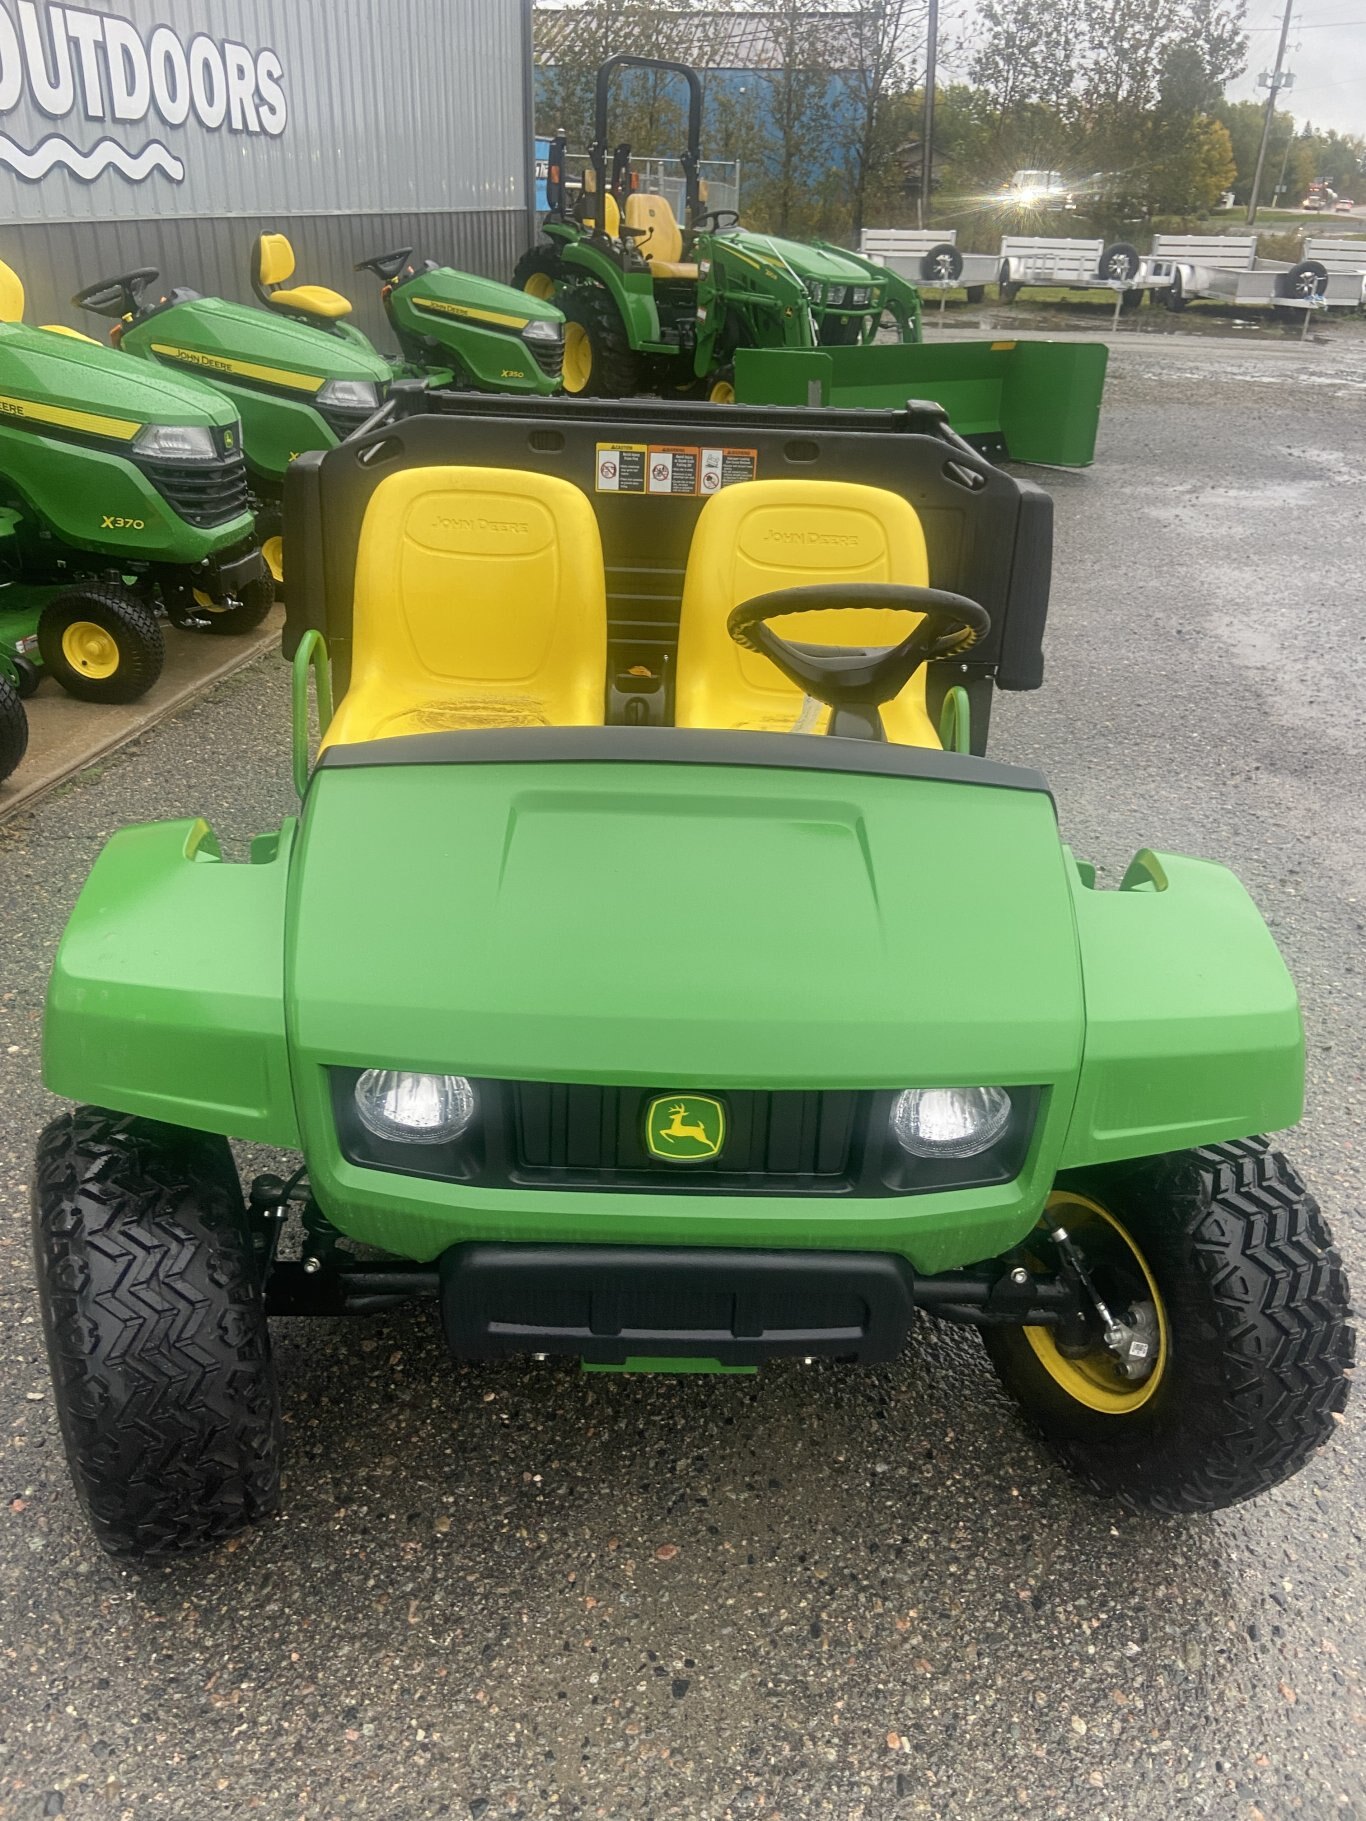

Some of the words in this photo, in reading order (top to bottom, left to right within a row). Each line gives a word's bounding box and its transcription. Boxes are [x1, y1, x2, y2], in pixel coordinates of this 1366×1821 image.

[176, 348, 200, 363] JOHN
[201, 355, 232, 372] DEERE
[0, 401, 25, 416] ERE
[101, 515, 145, 530] X370
[431, 515, 474, 530] JOHN
[477, 518, 529, 534] DEERE
[762, 529, 805, 545] JOHN
[806, 532, 859, 547] DEERE
